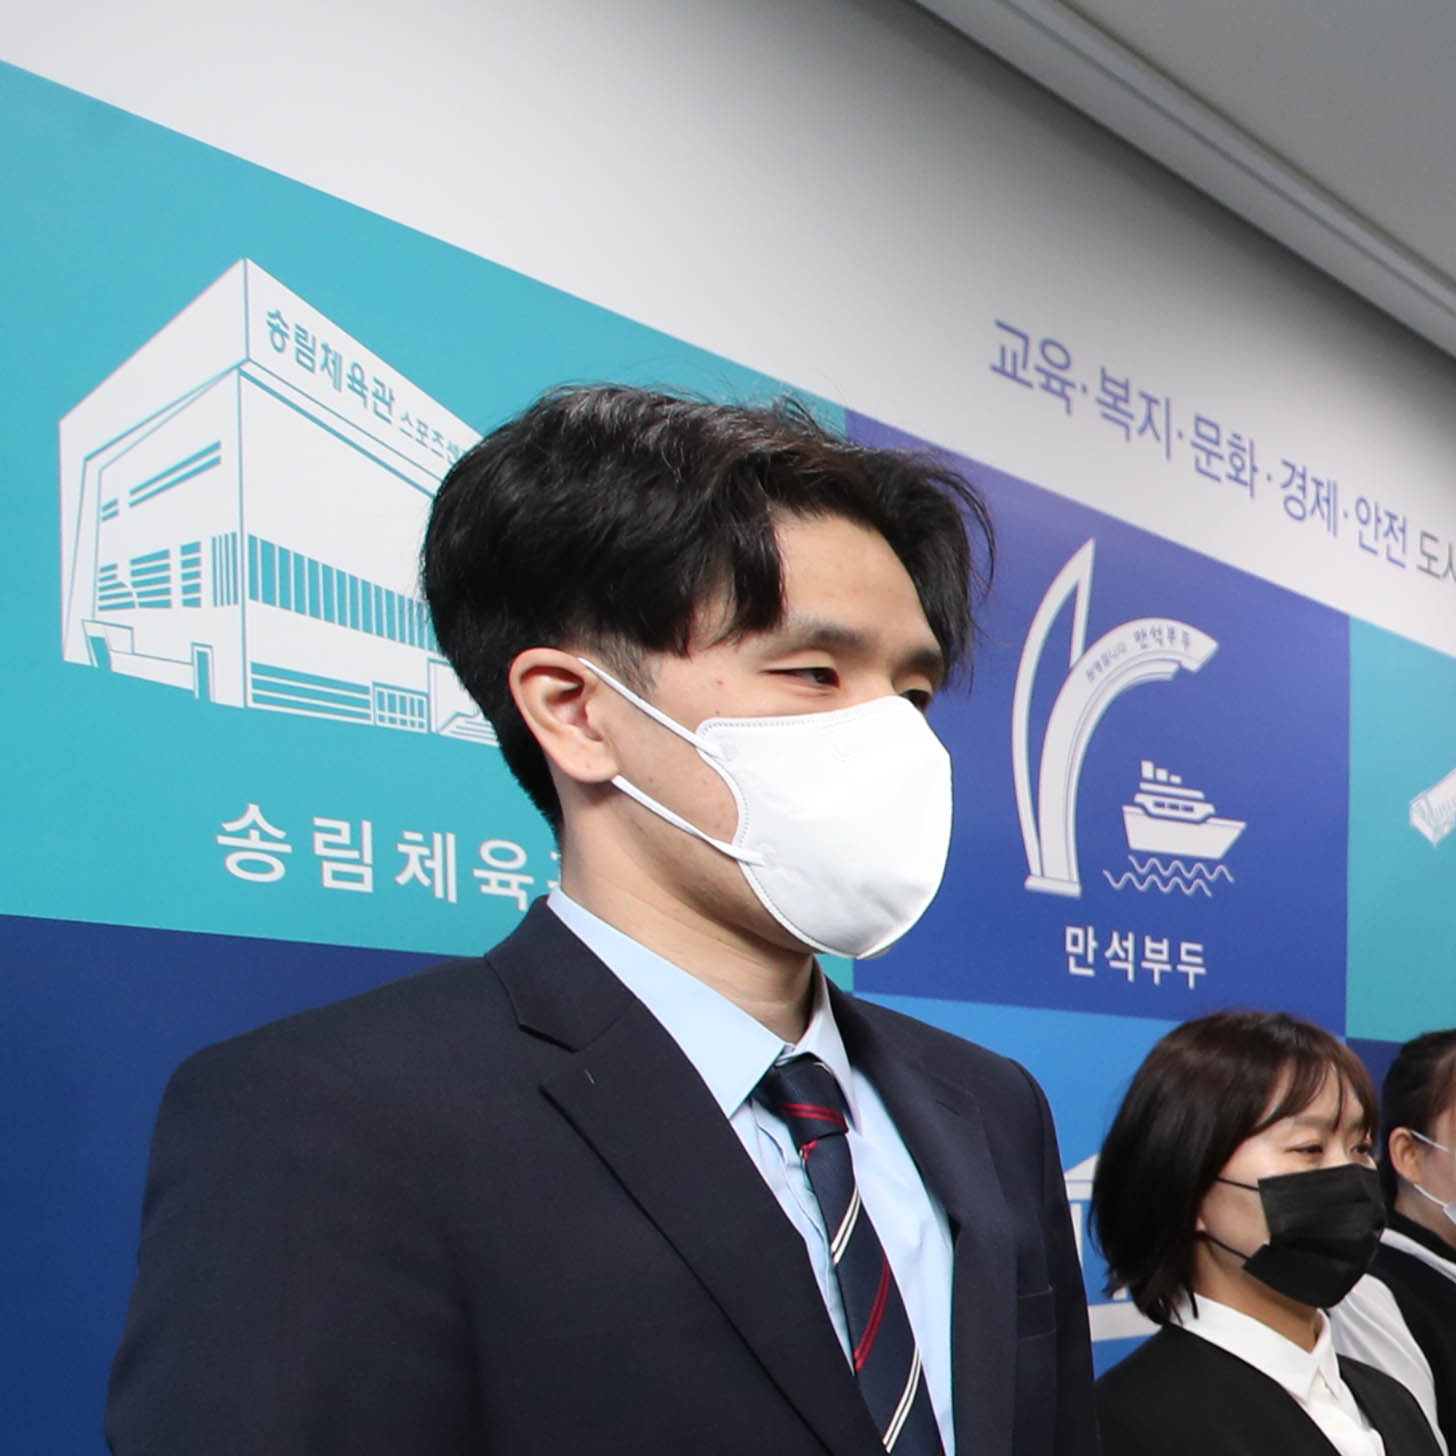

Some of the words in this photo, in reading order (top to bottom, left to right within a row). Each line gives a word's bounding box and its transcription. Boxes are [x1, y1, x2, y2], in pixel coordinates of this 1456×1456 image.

[266, 310, 395, 424] 송림체육관
[216, 802, 562, 912] 송림체육
[1064, 924, 1207, 990] 만석부두
